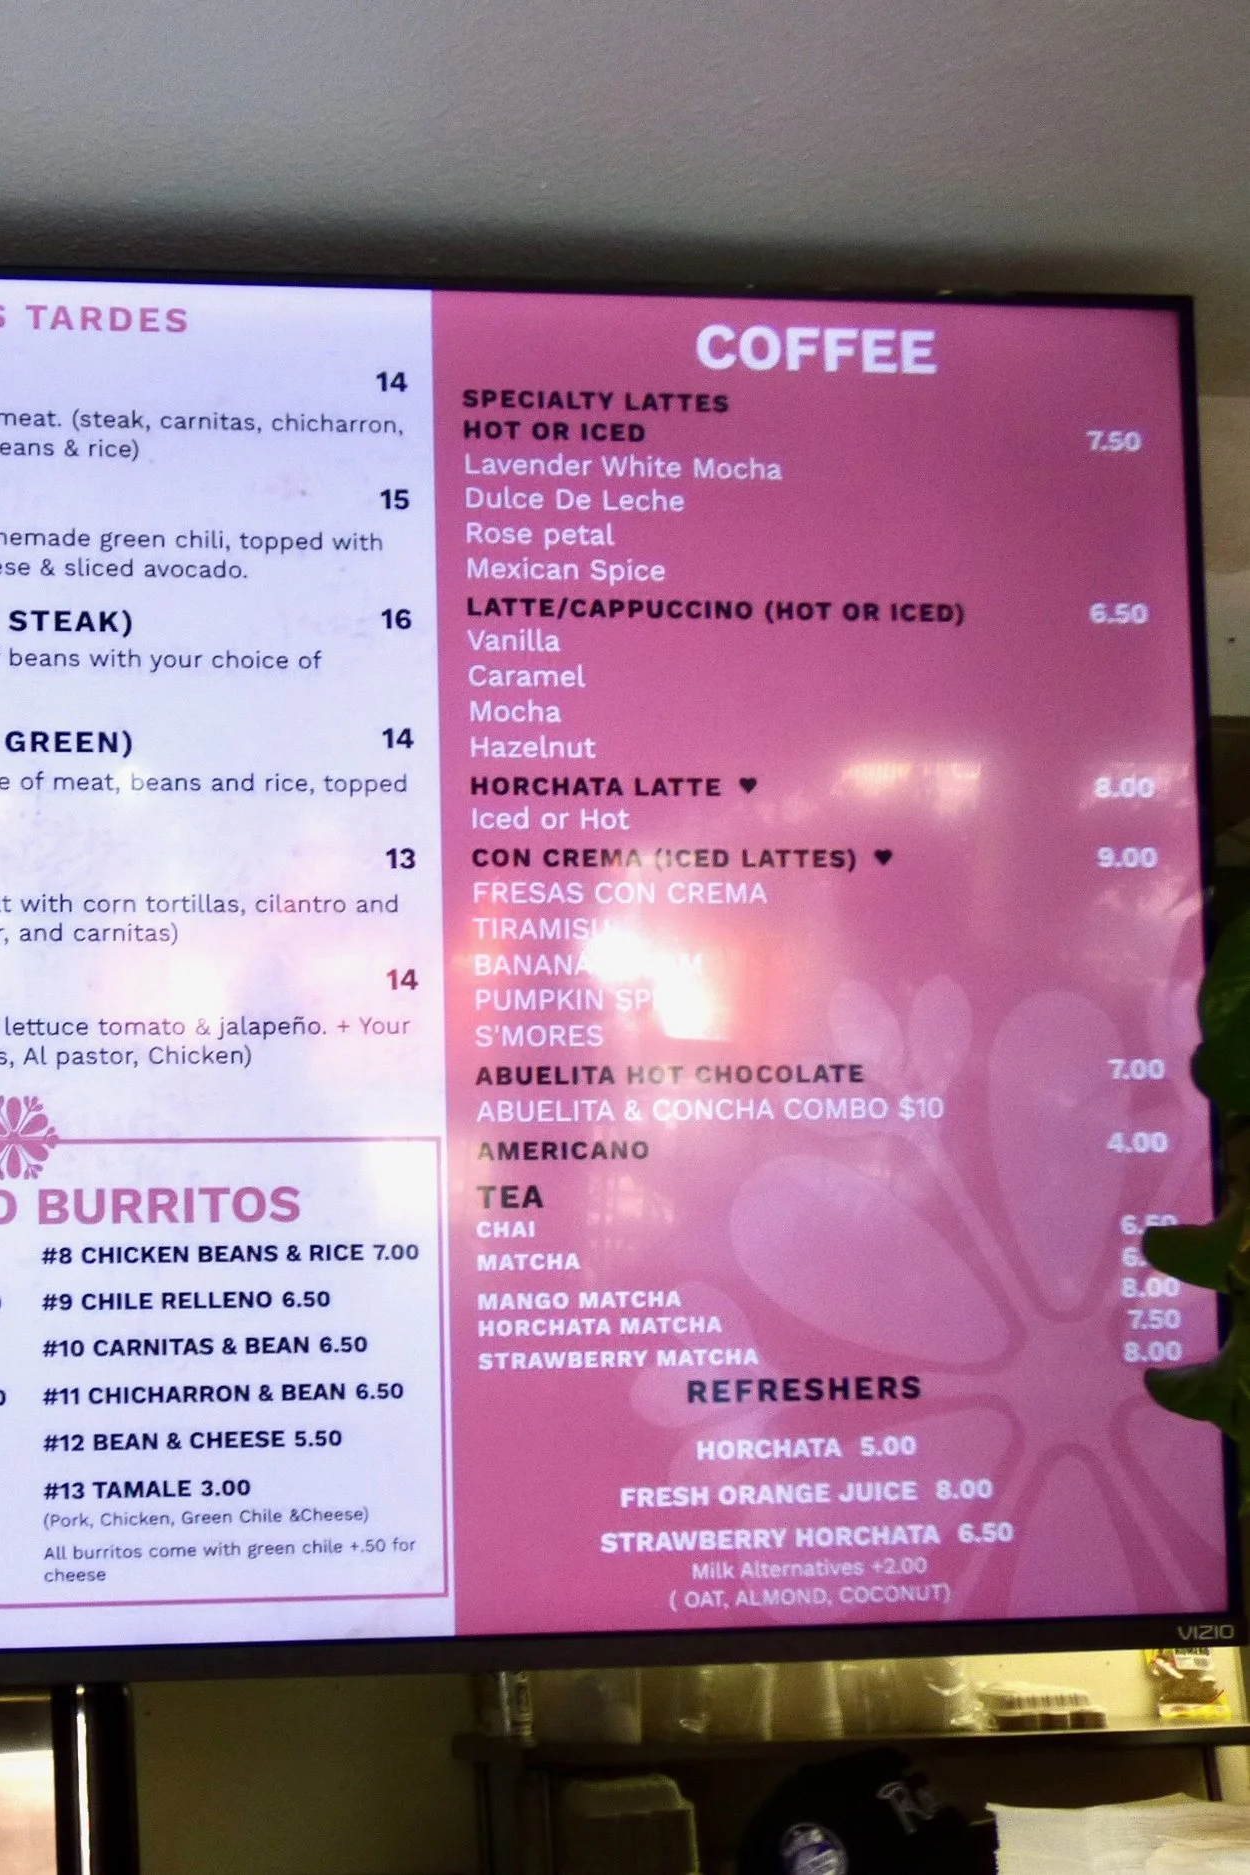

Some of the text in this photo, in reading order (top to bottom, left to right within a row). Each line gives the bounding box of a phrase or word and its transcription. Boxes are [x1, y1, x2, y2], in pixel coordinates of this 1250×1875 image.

[25, 304, 187, 333] TARDES
[696, 323, 937, 375] COFFEE
[376, 371, 408, 393] 14
[462, 388, 729, 414] SPECIALTY LATTES
[463, 419, 646, 443] HOT OR ICED
[1085, 429, 1142, 453] 7.50
[64, 439, 79, 457] &
[89, 439, 139, 462] rice)
[465, 452, 783, 481] Lavender White Mocha
[380, 488, 410, 510] 15
[465, 485, 685, 513] Dulce De Leche
[467, 556, 666, 587] Mexican Spice
[9, 609, 132, 638] STEAK)
[381, 608, 412, 630] 16
[467, 596, 966, 628] LATTE/CAPPUCCINO (HOT OR ICED)
[1088, 602, 1149, 625] 6.50
[466, 627, 562, 653] Vanilla
[468, 663, 587, 689] Caramel
[5, 730, 132, 759] GREEN)
[382, 727, 415, 749] 14
[470, 734, 597, 759] Hazelnut
[386, 847, 416, 870] 13
[387, 968, 419, 991] 14
[475, 1063, 865, 1086] ABUELITA HOT CHOCOLATE
[1106, 1058, 1166, 1081] 7.00
[477, 1140, 649, 1161] AMERICANO
[1106, 1131, 1169, 1154] 4.00
[38, 1185, 300, 1225] BURRITOS
[478, 1184, 544, 1209] TEA
[476, 1220, 535, 1239] CHAI
[476, 1252, 581, 1272] MATCHA
[687, 1375, 921, 1404] REFRESHERS
[696, 1434, 917, 1461] HORCHATA 5.00
[43, 1479, 251, 1500] #13 TAMALE 3.00
[620, 1478, 993, 1509] FRESH ORANGE JUICE 8.00
[43, 1507, 369, 1530] (Pork, Chicken, Green Chile &Cheese)
[600, 1521, 1014, 1554] STRAWBERRY HORCHATA 6.50
[1177, 1624, 1235, 1641] VIZIO
